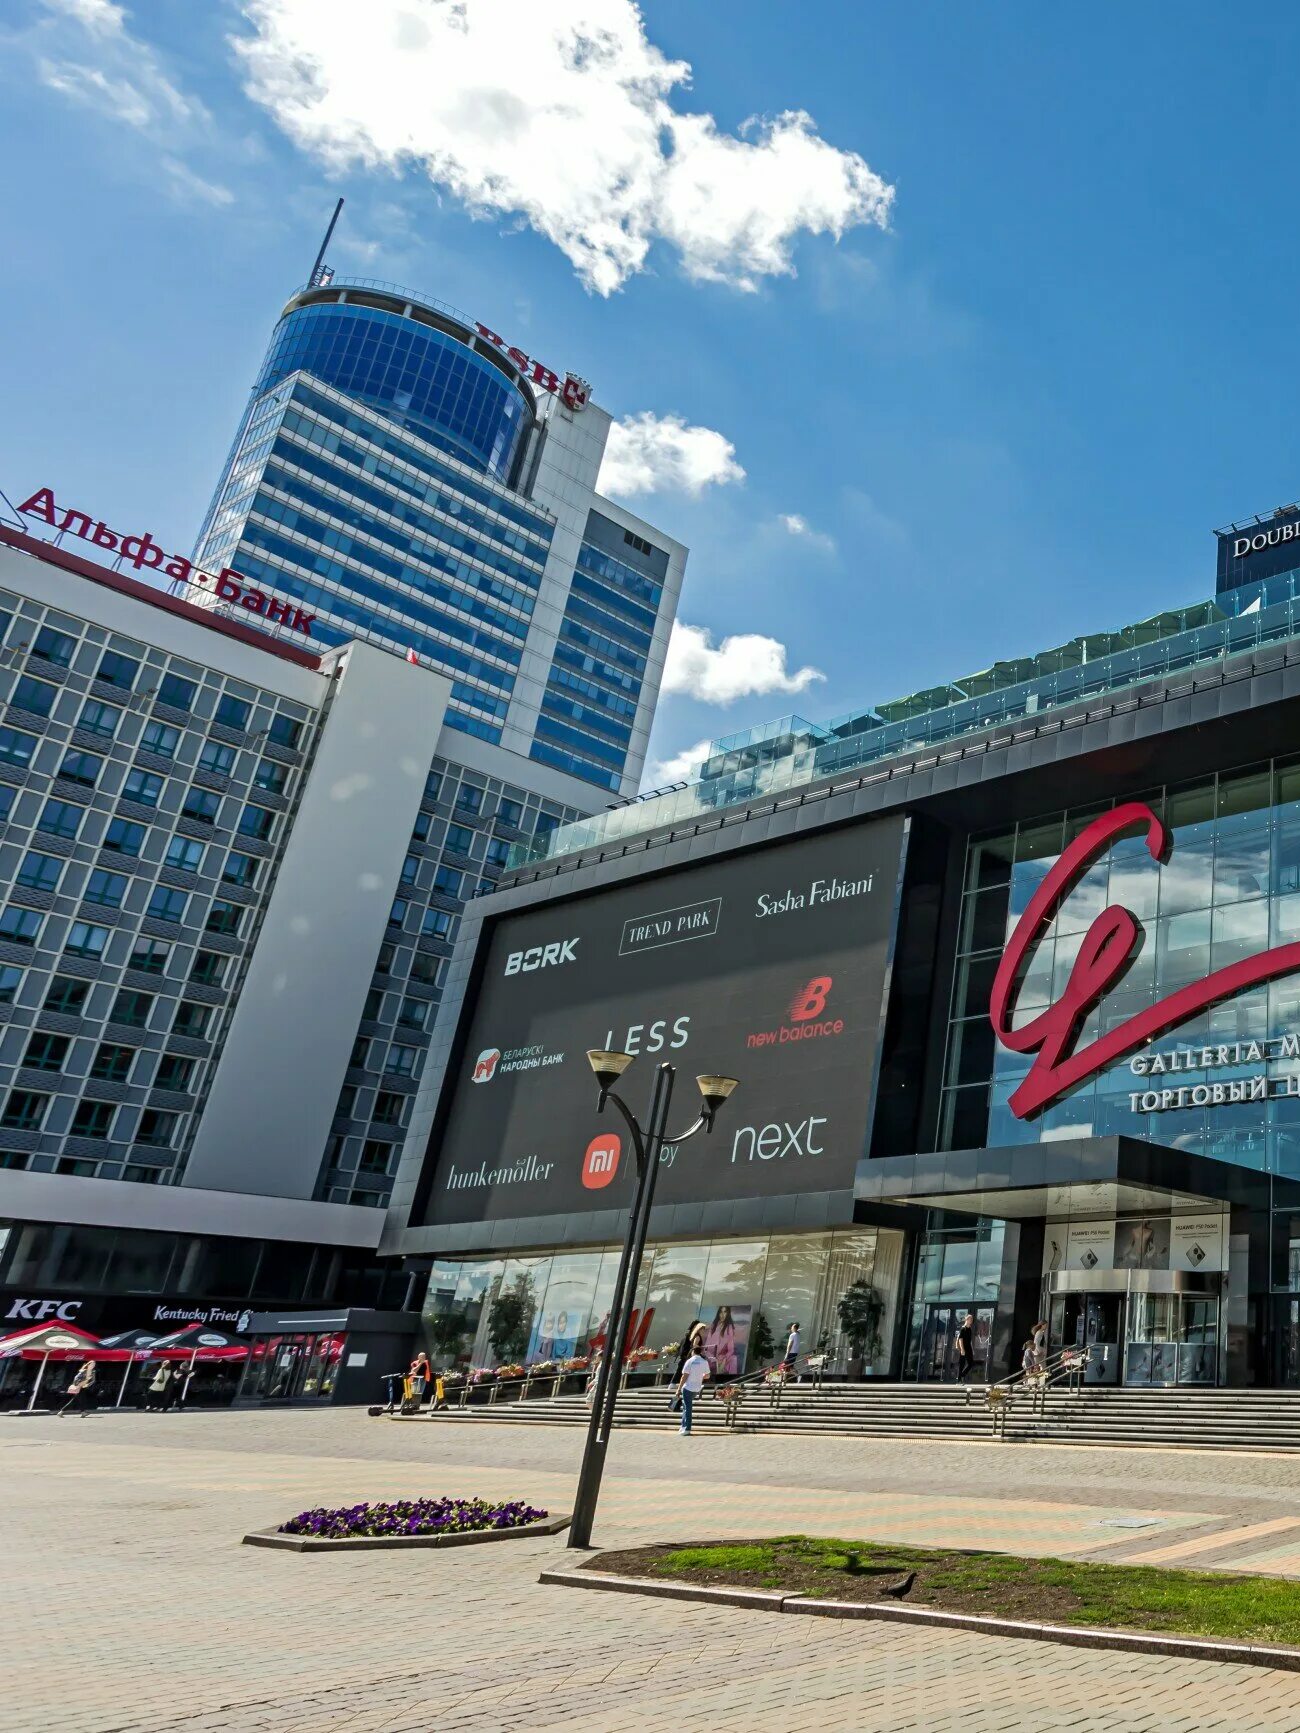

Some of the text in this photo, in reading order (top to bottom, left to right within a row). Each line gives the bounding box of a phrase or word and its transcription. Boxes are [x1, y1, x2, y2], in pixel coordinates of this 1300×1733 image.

[756, 874, 873, 918] Sasha Fabiani
[629, 910, 711, 943] TREND PARK
[504, 937, 580, 976] BORK
[746, 1019, 844, 1048] new balance
[500, 1053, 565, 1073] НАРОДНЫ БАНК
[1130, 1042, 1264, 1076] GALLERIA
[1128, 1076, 1268, 1113] ТОРГОВЫЙ
[731, 1116, 828, 1163] next
[4, 1298, 83, 1321] KFC
[154, 1305, 207, 1323] Kentucky
[209, 1307, 240, 1322] Fried
